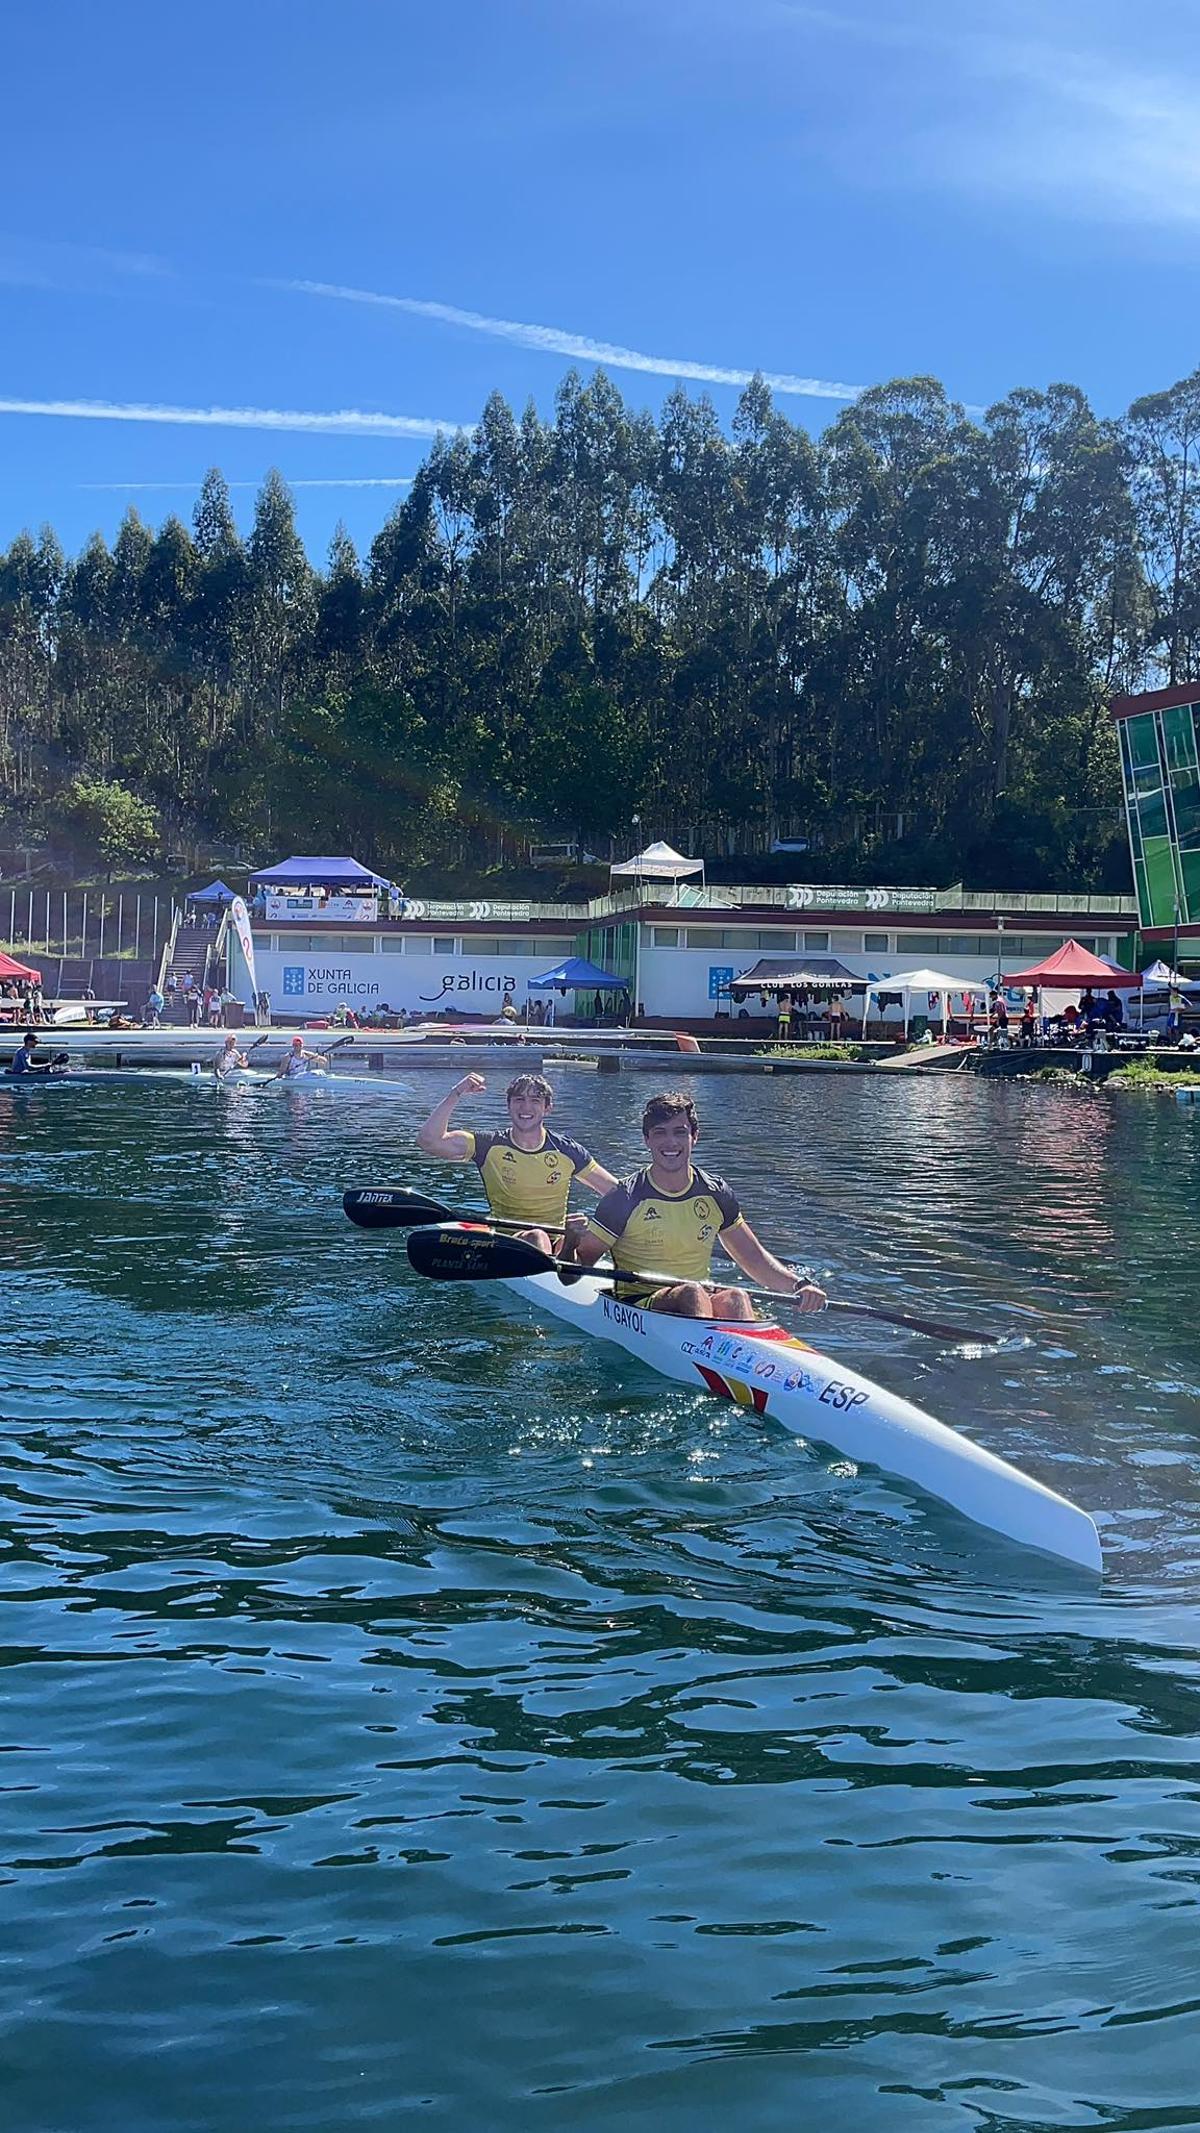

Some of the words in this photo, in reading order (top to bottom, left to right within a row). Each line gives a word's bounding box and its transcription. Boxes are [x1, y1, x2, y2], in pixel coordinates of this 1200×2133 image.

[816, 897, 859, 905] Pontevedra
[308, 968, 351, 980] XUNTA
[307, 982, 324, 994] DE
[327, 982, 379, 995] GALICIA
[419, 970, 516, 1001] galicia
[603, 1298, 612, 1320] N.
[613, 1304, 647, 1336] GAYOL
[818, 1380, 870, 1412] ESP
